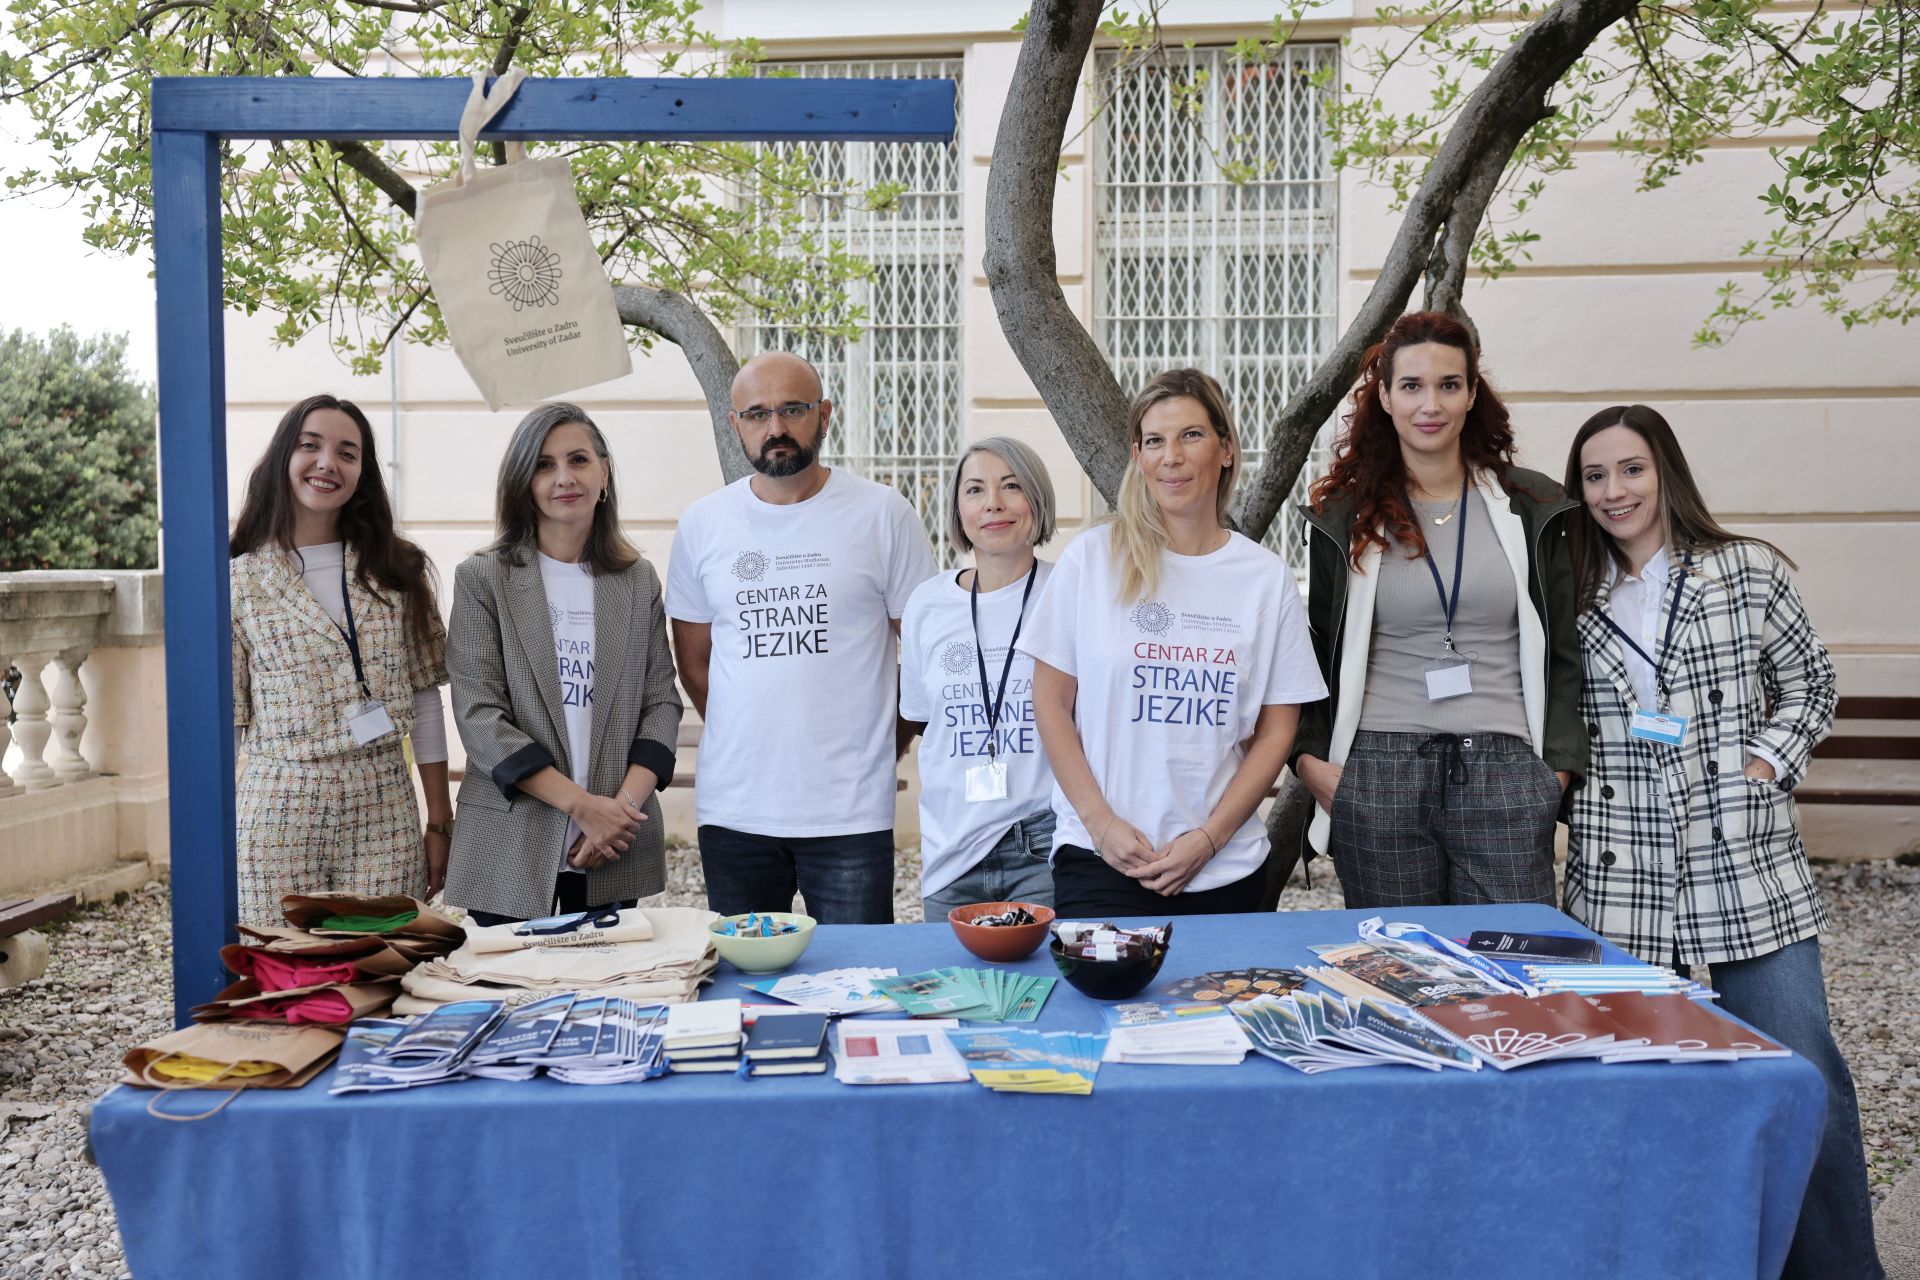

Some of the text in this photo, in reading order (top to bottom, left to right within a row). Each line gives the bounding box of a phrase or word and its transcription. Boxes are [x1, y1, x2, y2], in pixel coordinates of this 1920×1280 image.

[503, 328, 546, 346] Sveučilište
[553, 320, 578, 333] Zadru
[506, 331, 582, 357] University of Zadar
[736, 583, 828, 606] CENTAR ZA
[740, 603, 829, 631] STRANE
[554, 638, 590, 655] NTAR
[743, 629, 829, 659] JEZIKE
[1134, 642, 1237, 666] CENTAR ZA
[559, 656, 595, 680] RAN
[1132, 664, 1236, 695] STRANE
[562, 681, 594, 708] ZIK
[1012, 678, 1033, 695] ZA
[1131, 694, 1230, 727] JEZIKE
[949, 727, 1034, 758] JEZIKE
[522, 935, 571, 949] Sveučilište
[578, 930, 604, 941] Zadru
